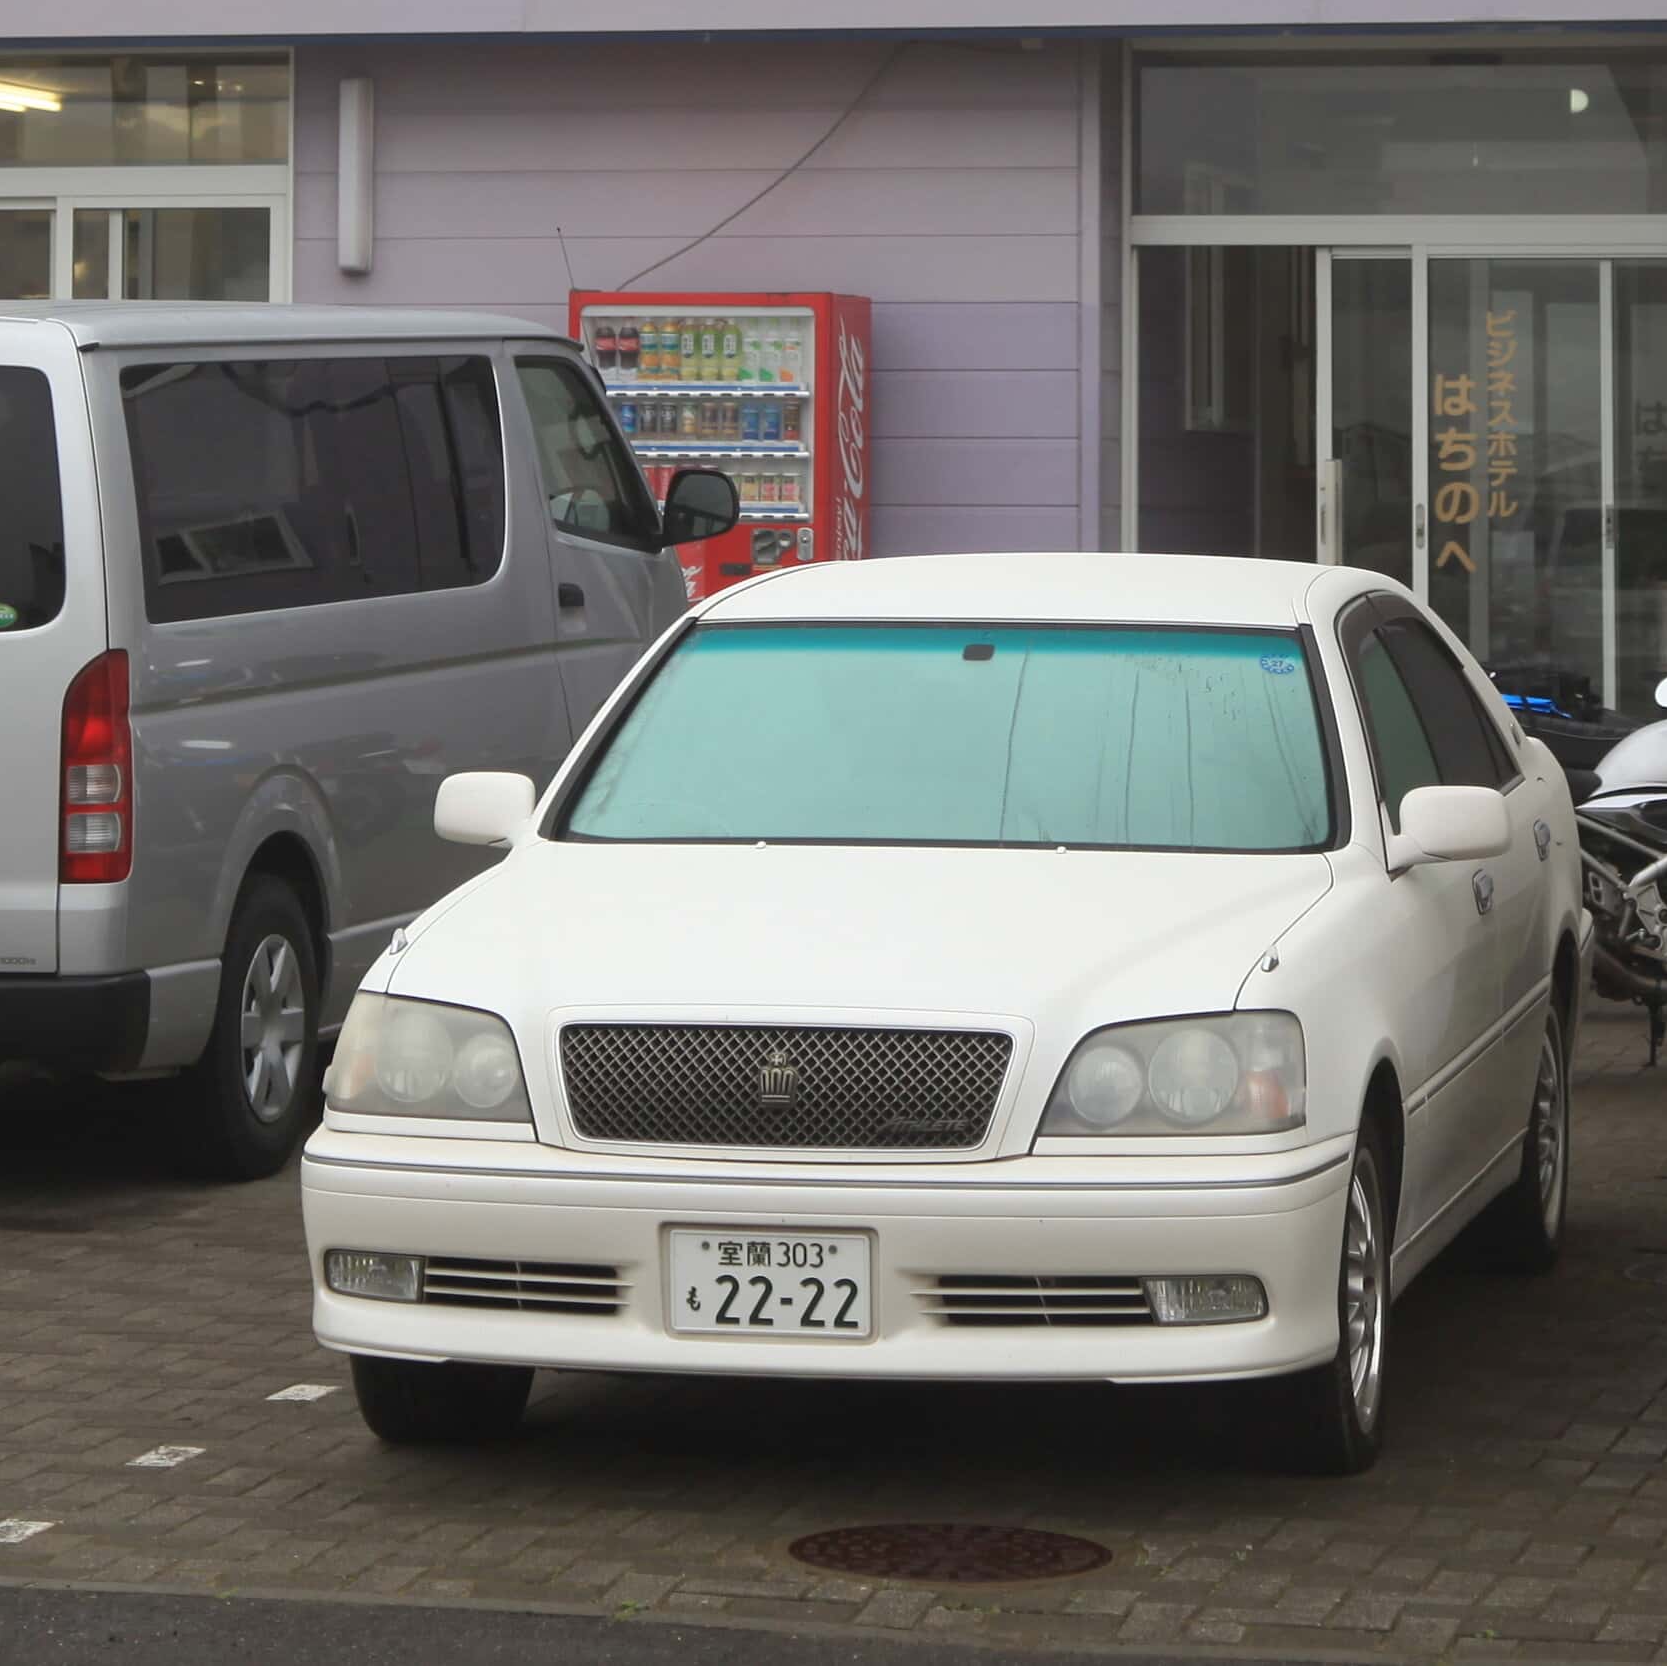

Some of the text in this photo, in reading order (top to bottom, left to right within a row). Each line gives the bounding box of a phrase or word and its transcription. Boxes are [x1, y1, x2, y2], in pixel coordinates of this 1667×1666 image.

[1434, 373, 1480, 573] はちのへ
[686, 1274, 859, 1328] も 22-22
